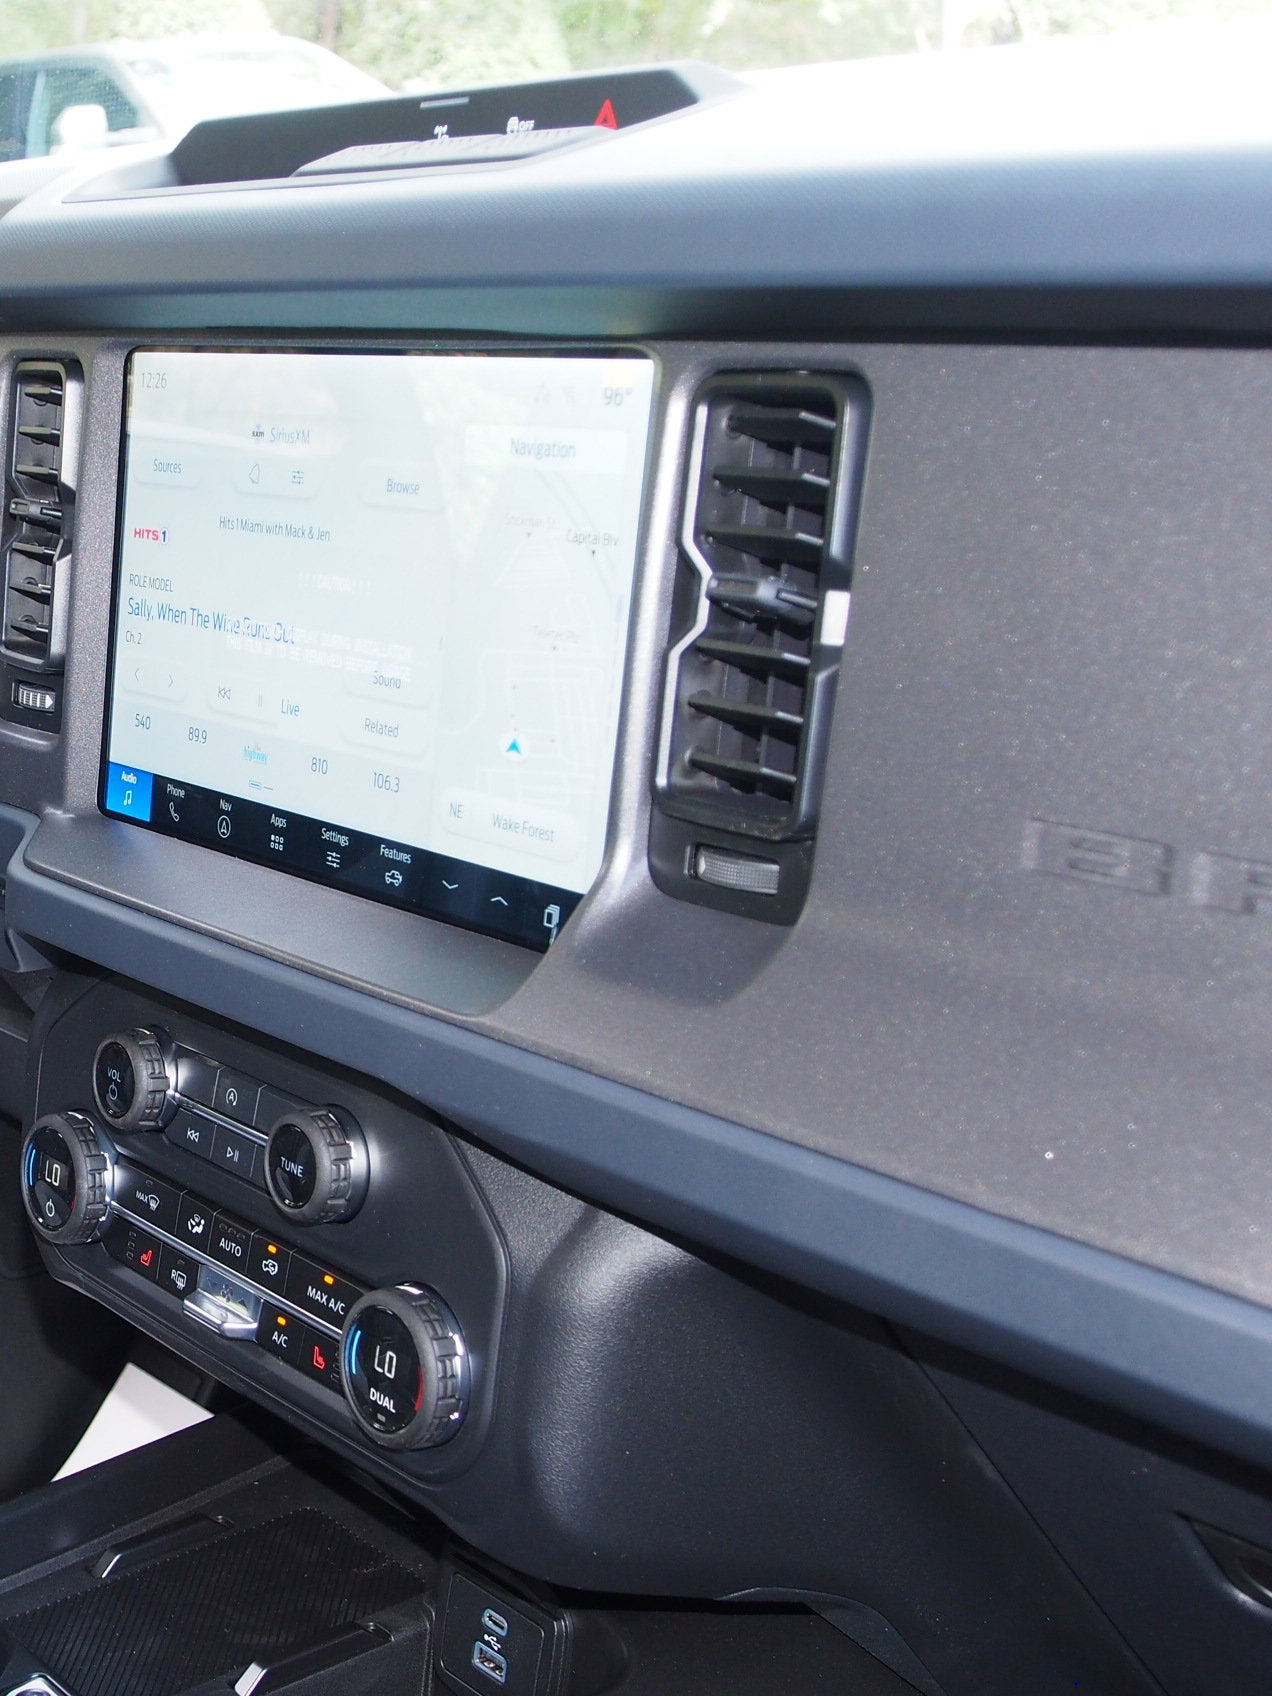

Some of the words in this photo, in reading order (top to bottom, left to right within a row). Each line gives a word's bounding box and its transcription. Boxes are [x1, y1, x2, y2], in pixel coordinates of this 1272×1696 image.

[141, 372, 167, 389] 12:26
[270, 427, 310, 444] SiriusXM
[509, 436, 577, 461] Navigation
[153, 459, 182, 475] Sources
[386, 479, 421, 495] Browse
[134, 527, 159, 541] HITS
[161, 530, 167, 543] 1
[219, 516, 234, 530] Hits
[239, 519, 264, 534] Miami
[265, 521, 283, 536] with
[284, 522, 306, 539] Mack
[307, 526, 315, 539] &
[316, 526, 330, 541] Jen
[566, 529, 600, 546] Capital
[129, 573, 147, 589] ROLE
[148, 576, 174, 593] MODEL
[127, 597, 153, 622] Sally,
[157, 601, 187, 626] When
[189, 607, 210, 629] The
[125, 630, 136, 644] Ch.
[137, 631, 142, 645] 2
[280, 696, 301, 718] Live
[135, 713, 151, 731] 540
[364, 717, 400, 739] Related
[188, 726, 208, 745] 89.9
[310, 755, 328, 775] 810
[120, 771, 137, 785] Audio
[373, 771, 401, 793] 106.3
[166, 784, 185, 800] Phone
[219, 799, 232, 813] Nav
[270, 813, 287, 829] Apps
[449, 801, 464, 819] NE
[492, 812, 520, 835] Wake
[521, 820, 557, 844] Forest
[321, 827, 350, 848] Settings
[379, 844, 413, 865] Features
[107, 1067, 121, 1083] VOL
[45, 1159, 60, 1187] LO
[280, 1156, 304, 1178] TUNE
[136, 1189, 149, 1203] MAX
[218, 1237, 242, 1257] AUTO
[170, 1269, 177, 1280] R
[307, 1285, 328, 1307] MAX
[328, 1295, 346, 1316] A/C
[271, 1330, 289, 1349] A/C
[374, 1345, 397, 1379] LO
[369, 1387, 396, 1414] DUAL
